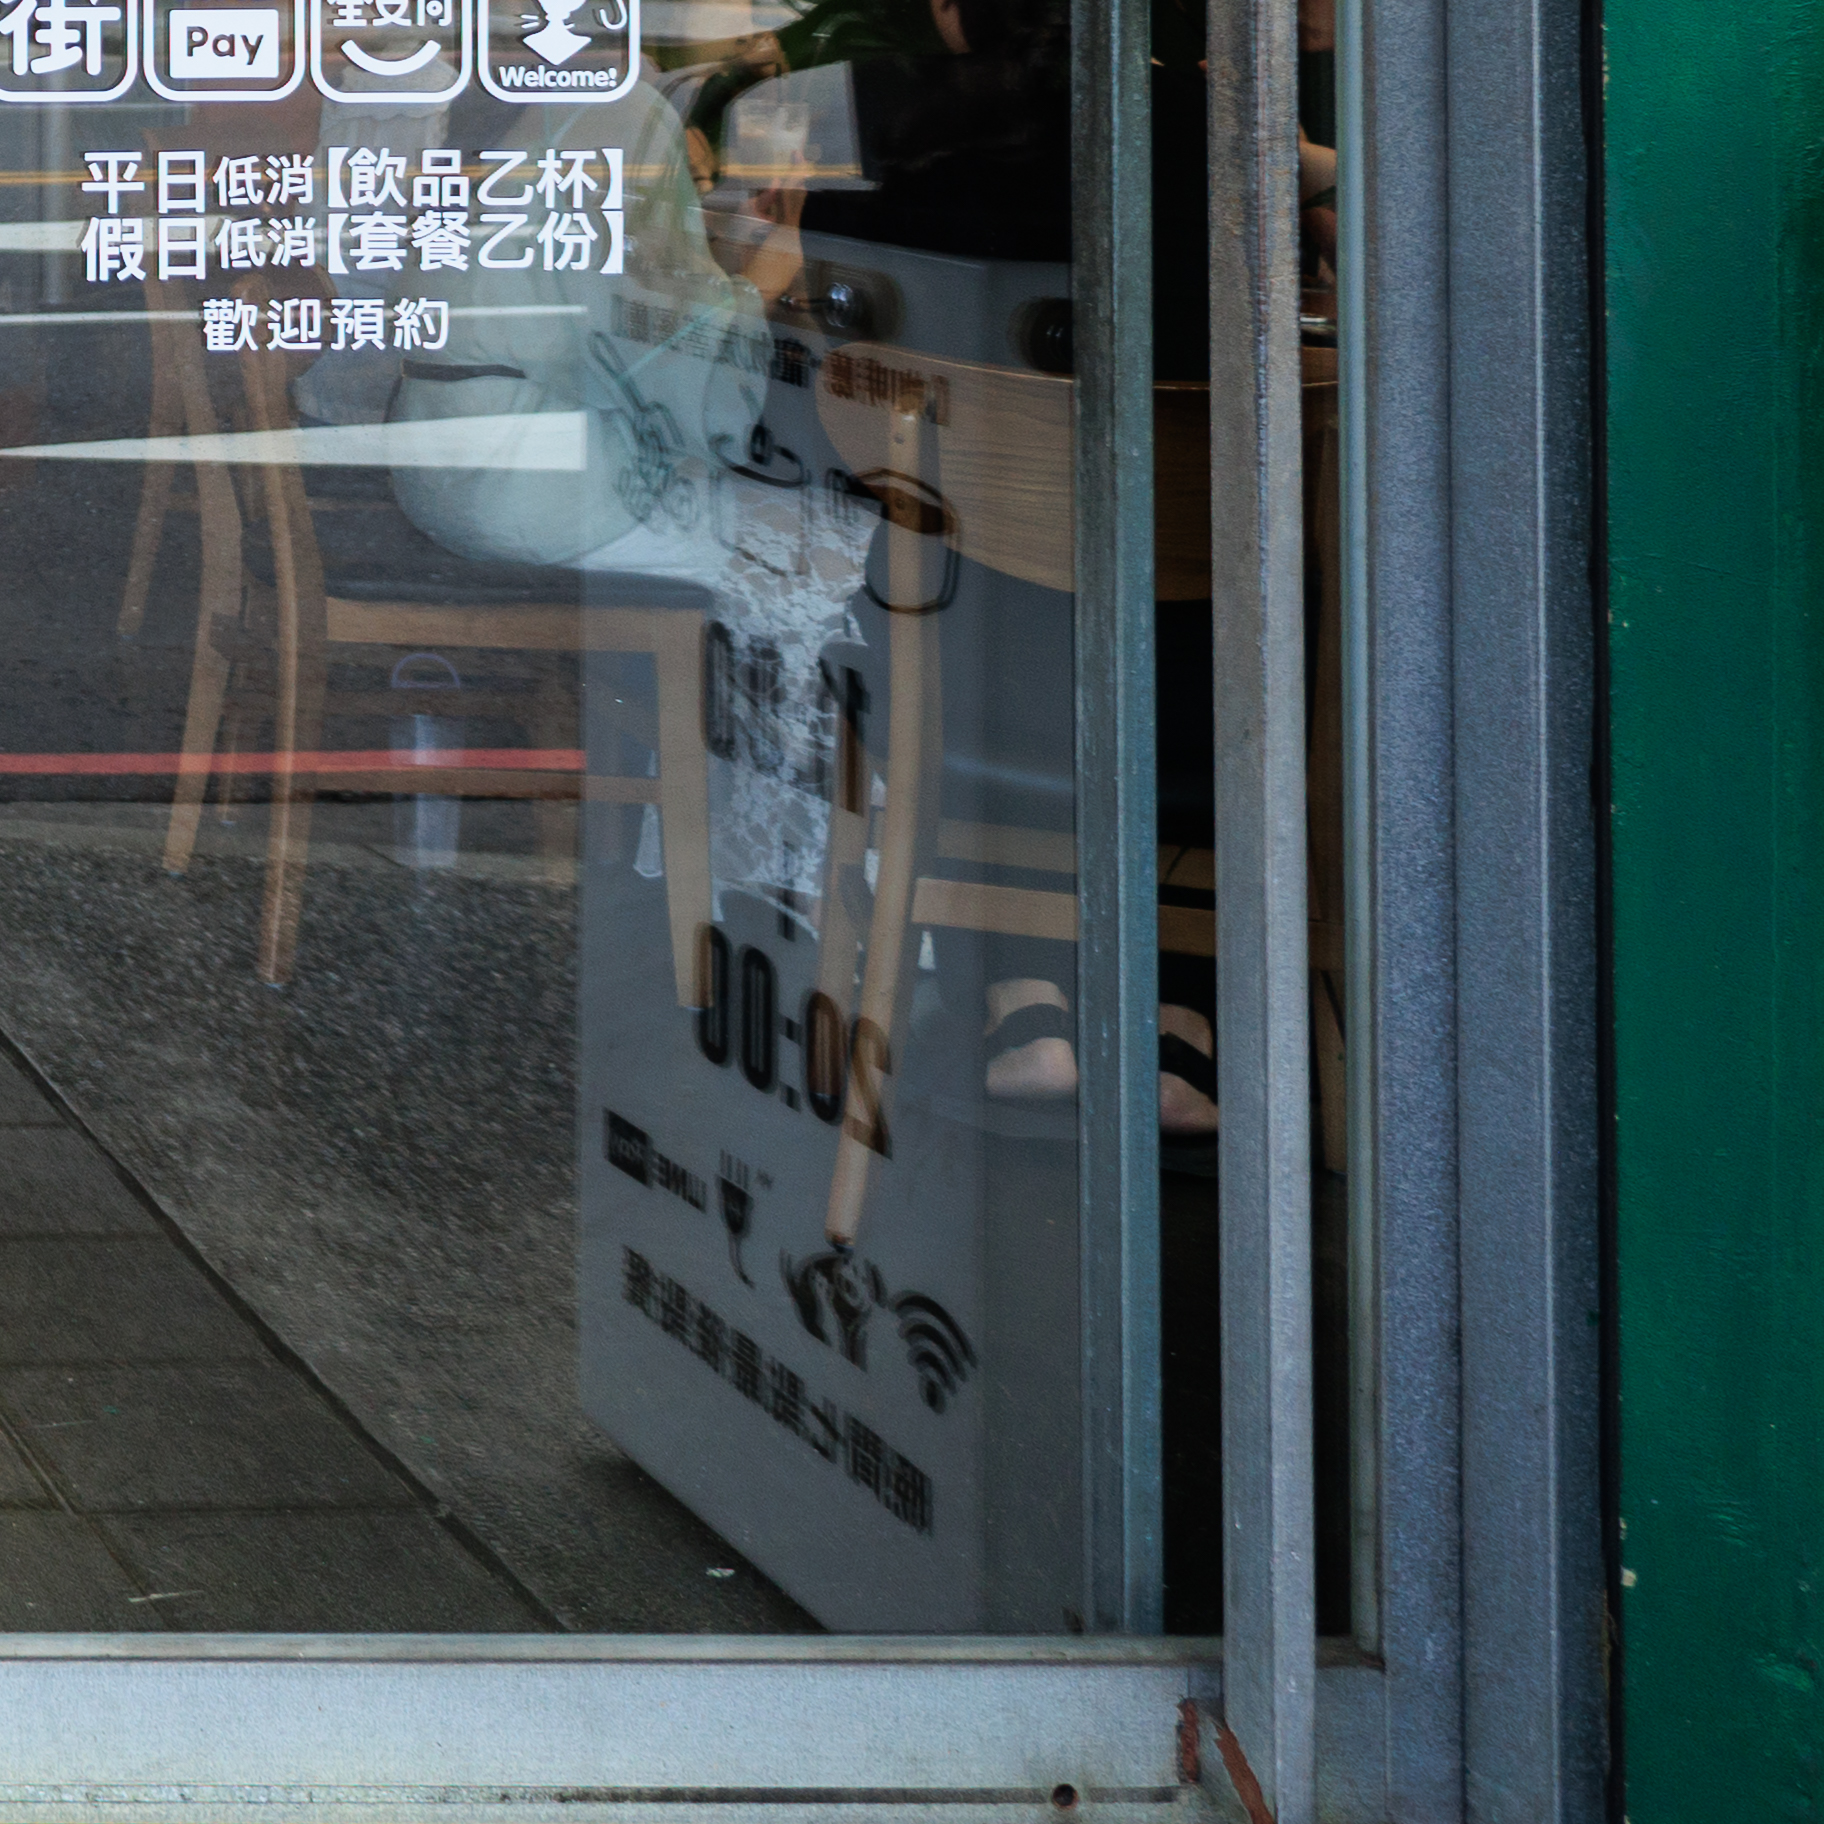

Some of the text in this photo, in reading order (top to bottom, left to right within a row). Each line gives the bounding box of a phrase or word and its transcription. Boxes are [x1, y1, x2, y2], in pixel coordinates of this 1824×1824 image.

[186, 26, 265, 66] Pay
[498, 64, 619, 90] Welcome!
[202, 299, 451, 352] 歡迎預約
